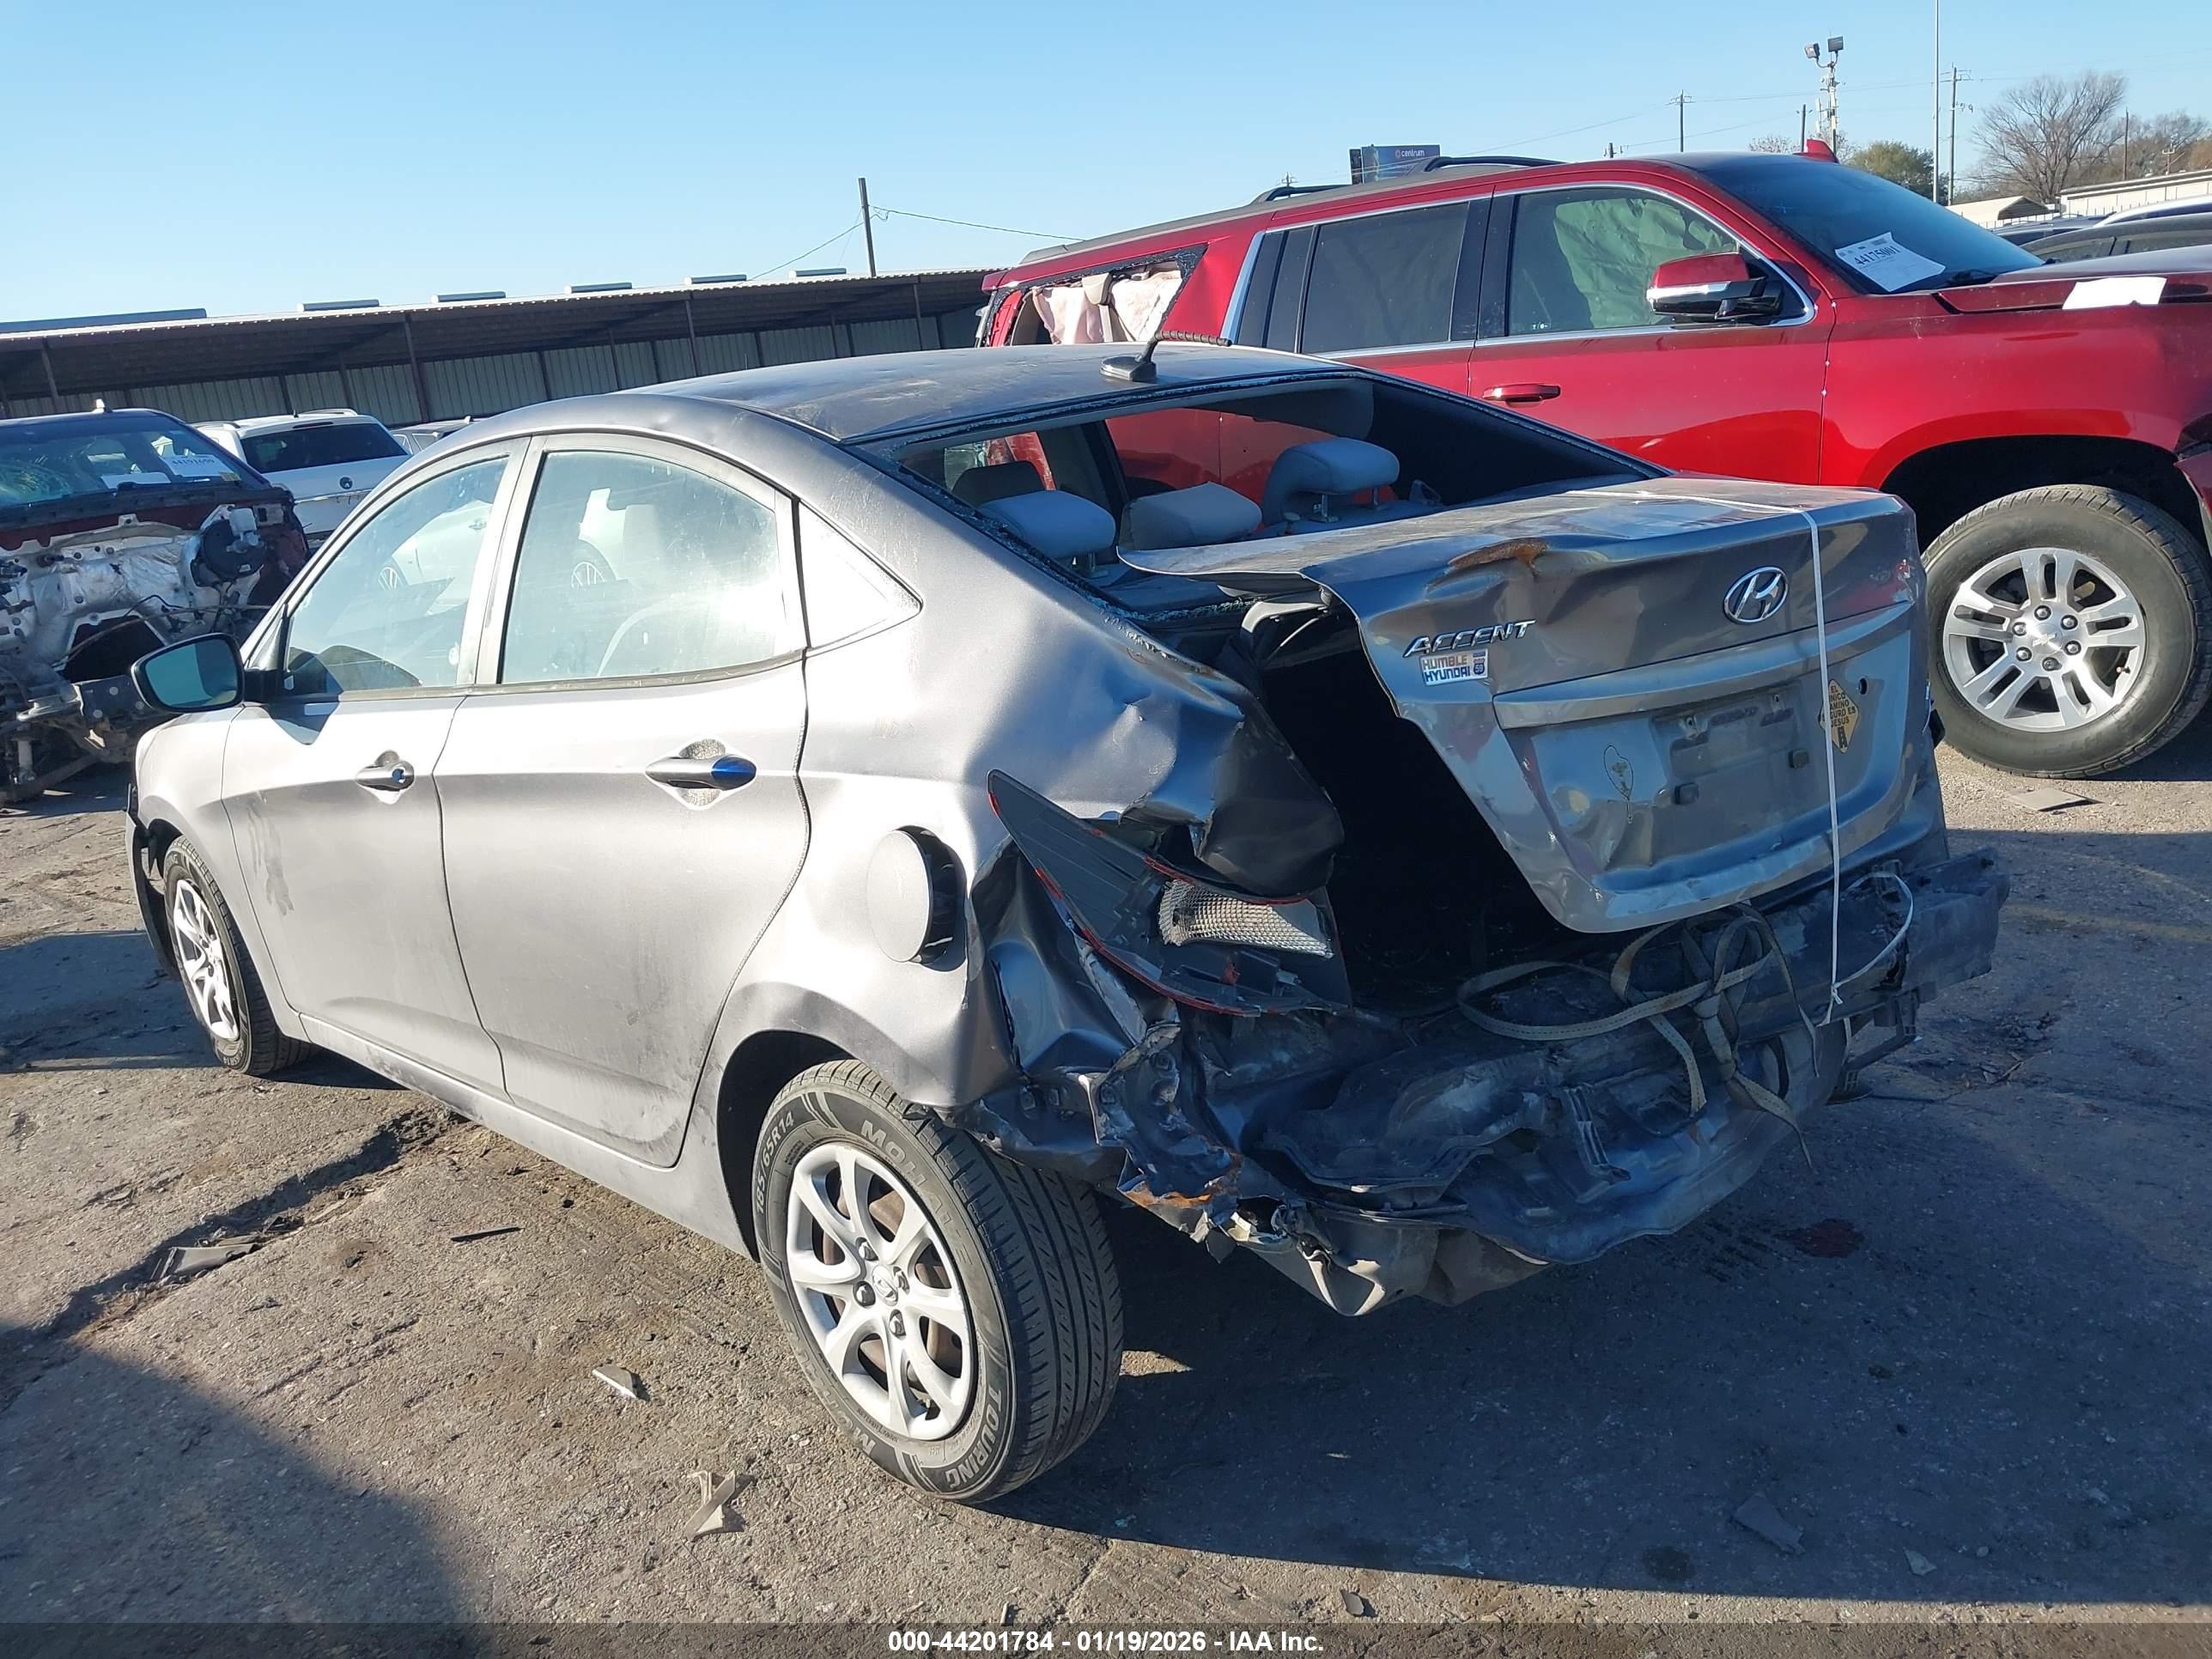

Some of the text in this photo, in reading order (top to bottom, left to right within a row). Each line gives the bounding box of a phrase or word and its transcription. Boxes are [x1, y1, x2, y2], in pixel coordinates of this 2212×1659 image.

[1402, 619, 1536, 658] ACCENT
[1422, 654, 1468, 671] HUMBLE
[1424, 666, 1471, 682] HYUNDAI
[1848, 706, 1856, 714] ES
[757, 1111, 794, 1214] 185/65R14
[945, 1386, 1002, 1488] TOURING
